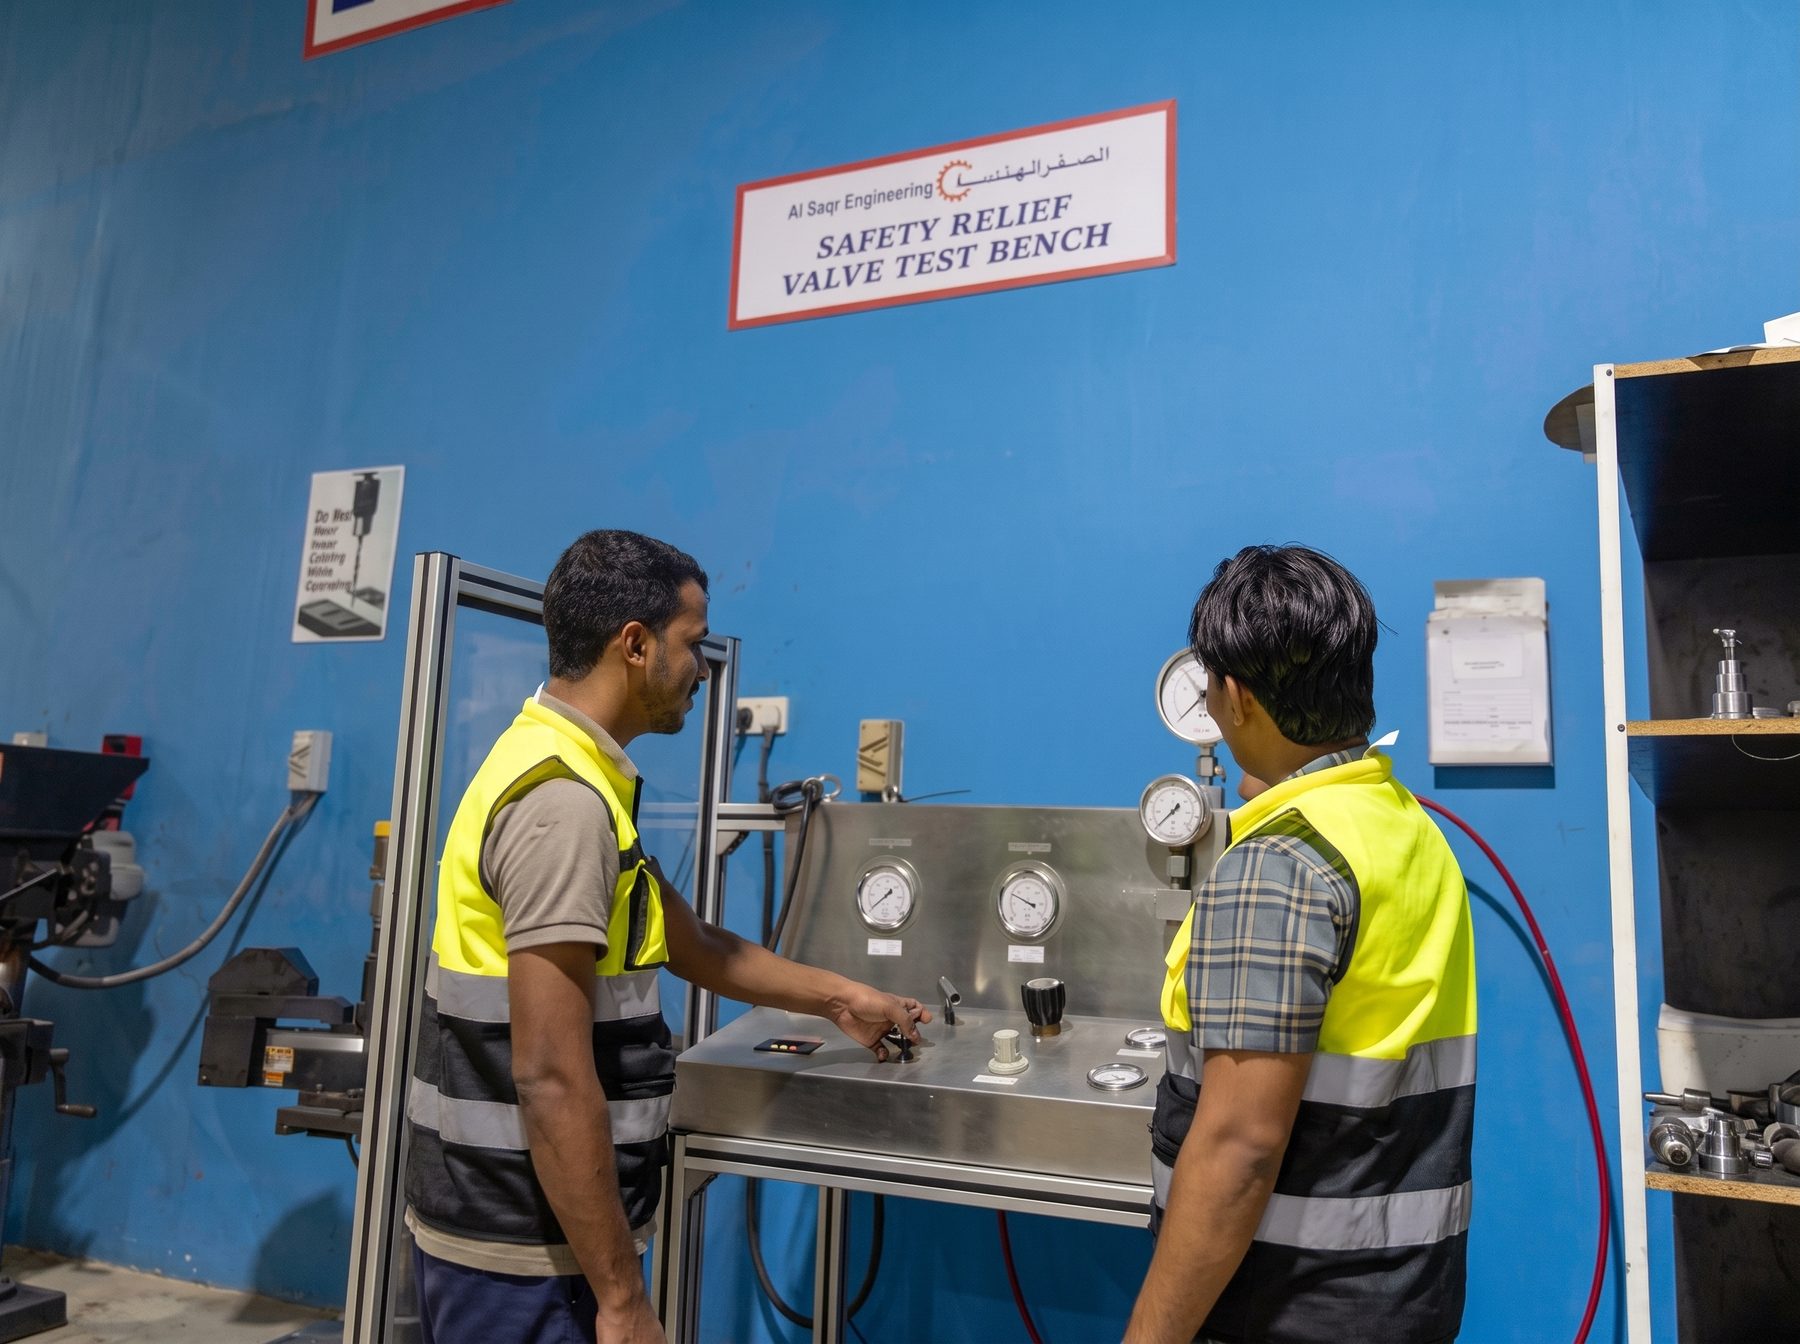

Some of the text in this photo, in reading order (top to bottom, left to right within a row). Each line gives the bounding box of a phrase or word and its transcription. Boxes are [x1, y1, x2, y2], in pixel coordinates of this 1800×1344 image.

[788, 182, 933, 220] Al Saqr Engineering
[816, 194, 1073, 260] SAFETY RELIEF
[782, 222, 1112, 296] VALVE TEST BENCH
